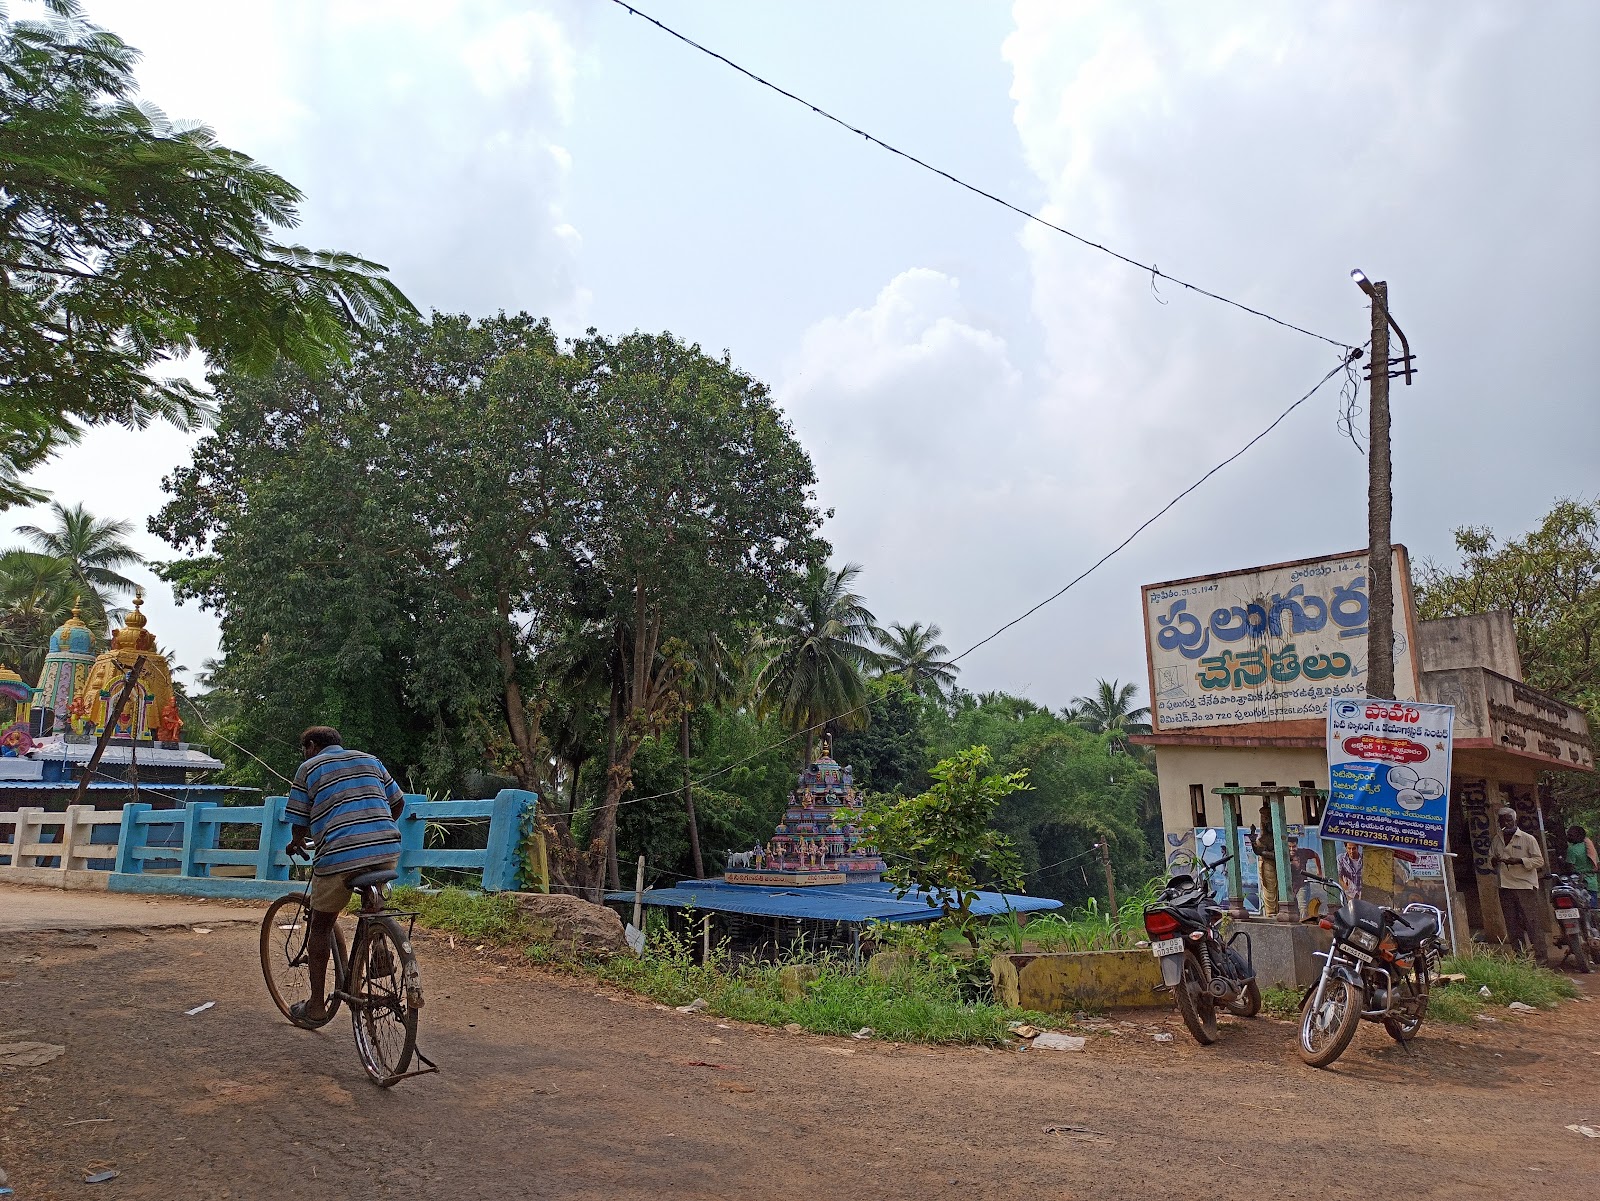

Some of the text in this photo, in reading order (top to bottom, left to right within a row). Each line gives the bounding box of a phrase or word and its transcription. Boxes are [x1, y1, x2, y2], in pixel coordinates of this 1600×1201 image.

[1196, 643, 1352, 691] చేనేతలు
[1365, 703, 1420, 724] పావని
[1390, 834, 1439, 847] 7416711855
